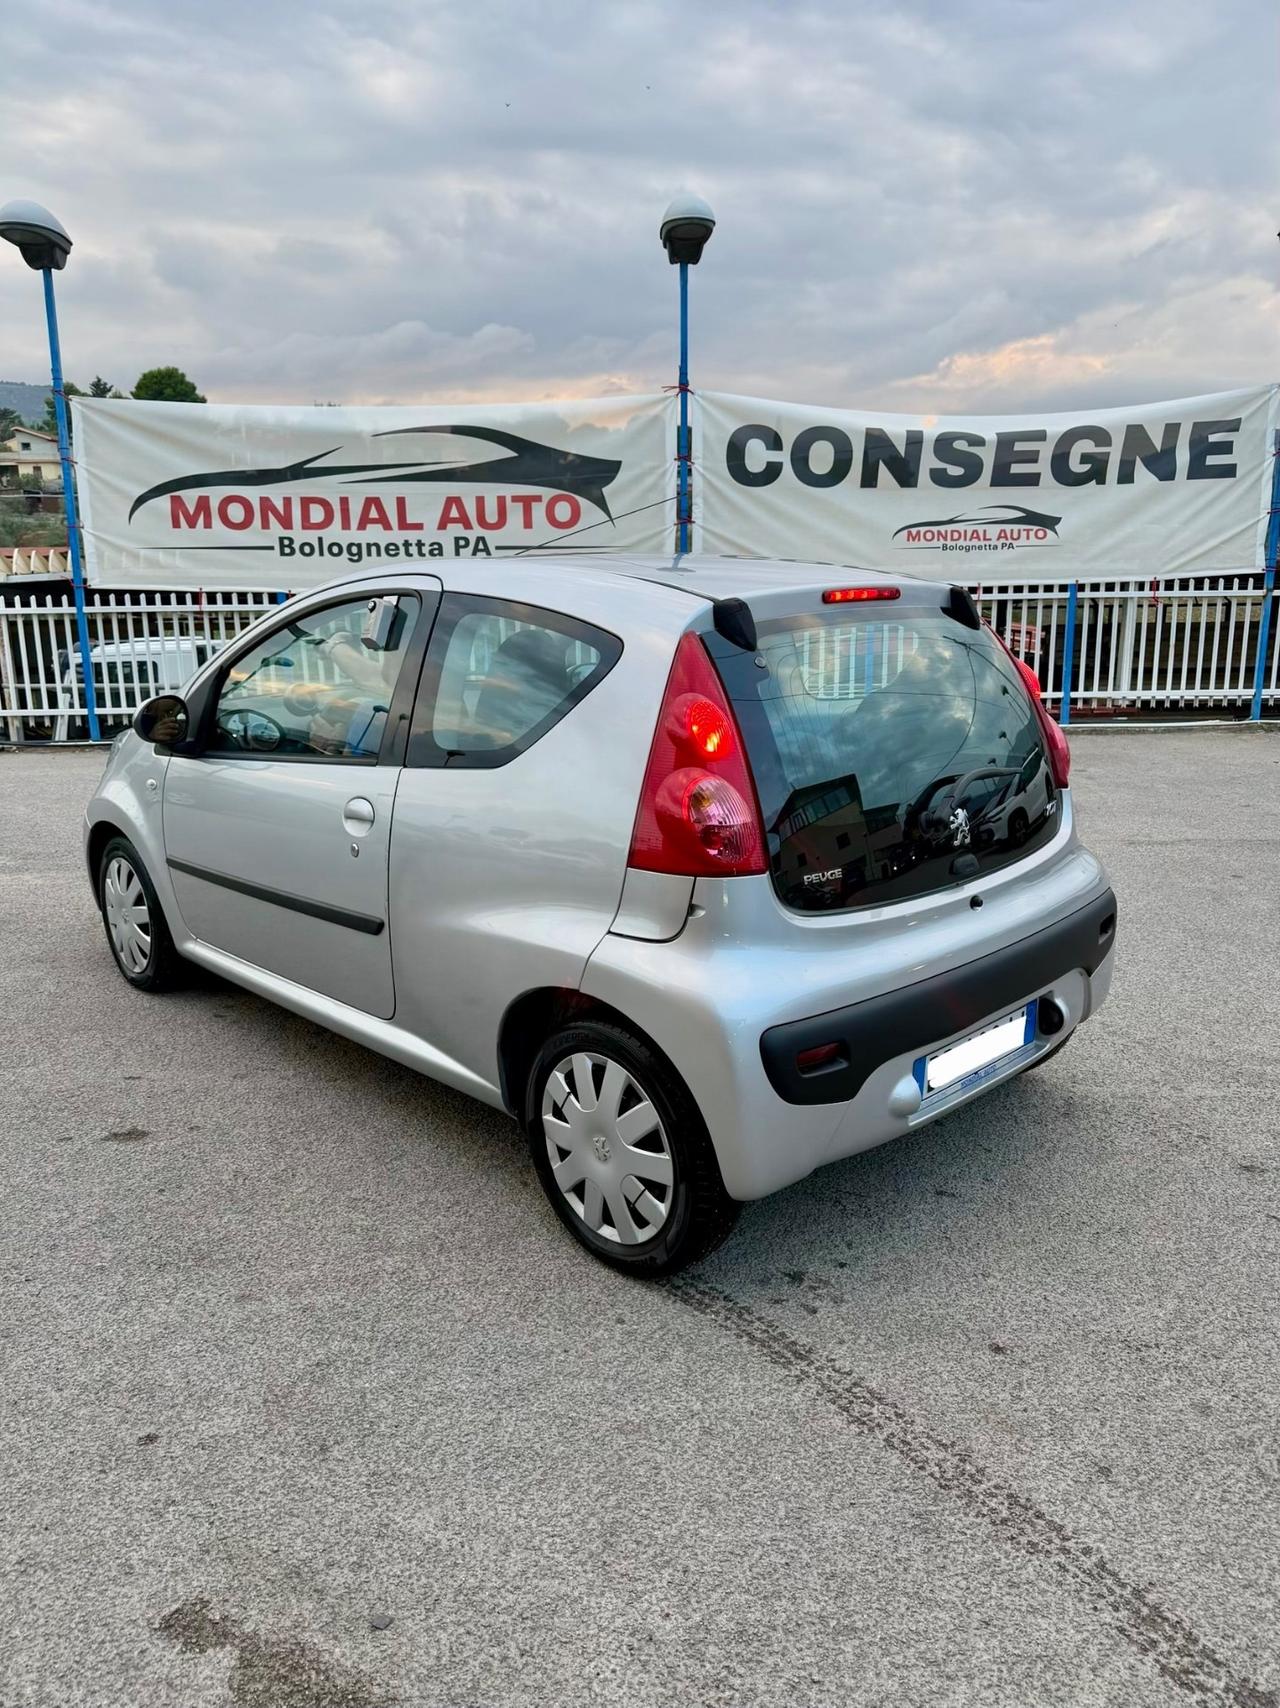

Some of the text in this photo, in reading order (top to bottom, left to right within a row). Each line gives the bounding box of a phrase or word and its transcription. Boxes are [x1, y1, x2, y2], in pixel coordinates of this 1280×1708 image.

[726, 418, 1242, 490] CONSEGNE
[170, 494, 581, 531] MONDIAL AUTO
[906, 528, 1048, 542] MONDIAL AUTO
[941, 542, 1015, 553] Bolognetta PA
[278, 536, 492, 562] Bolognetta PA
